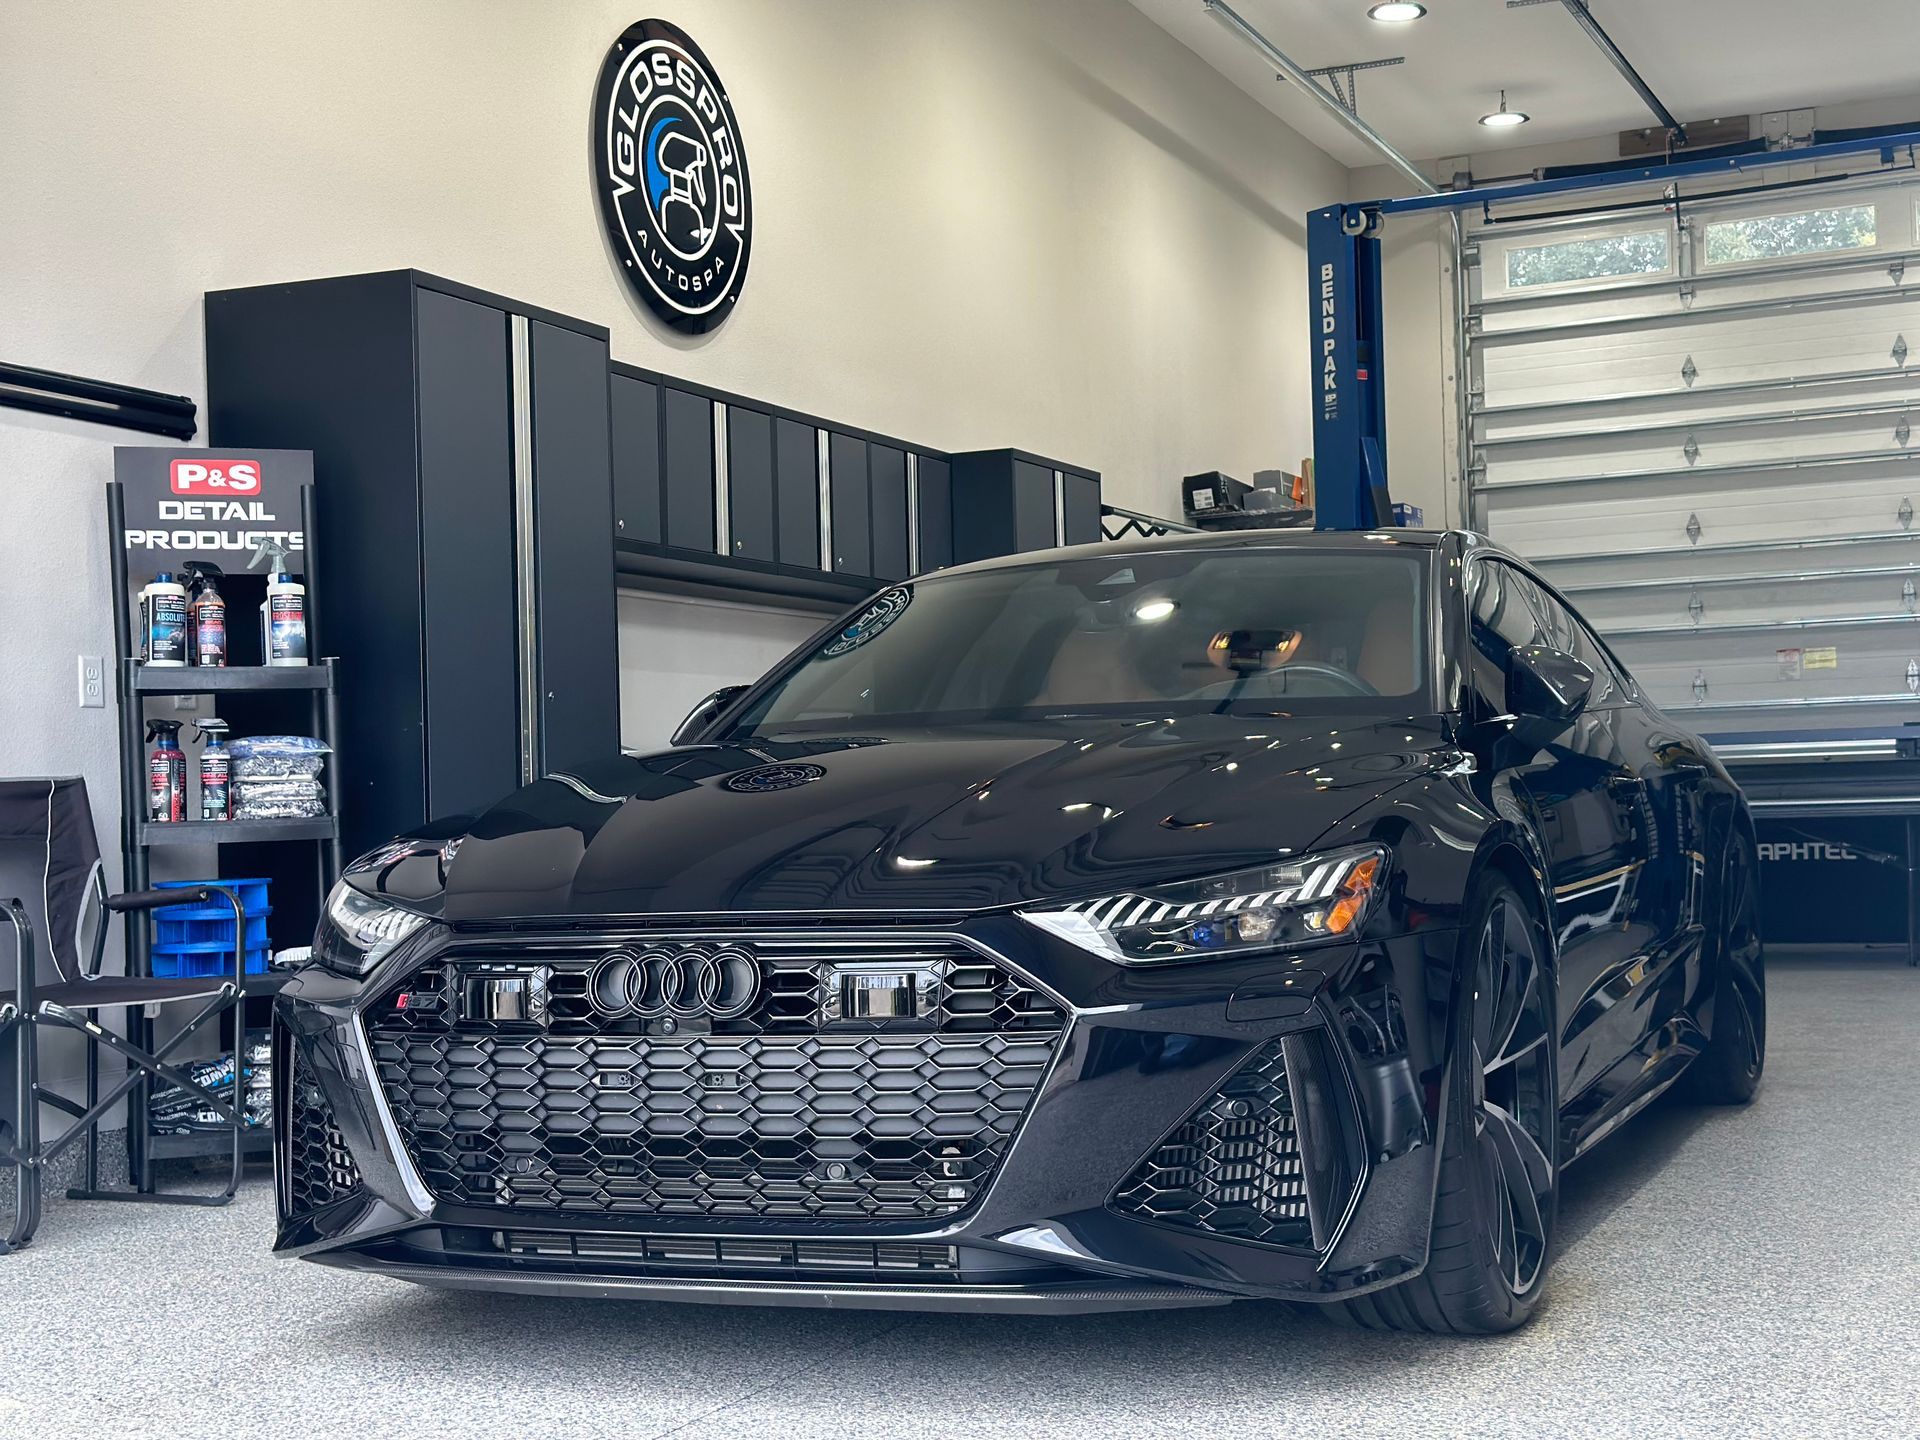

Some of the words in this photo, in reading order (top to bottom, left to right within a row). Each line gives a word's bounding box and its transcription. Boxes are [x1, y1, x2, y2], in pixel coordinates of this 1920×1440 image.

[617, 53, 738, 217] GLOSSPRO
[637, 229, 725, 292] AUTOSPA
[1321, 263, 1335, 334] BEND
[1323, 338, 1337, 391] PAK
[177, 464, 257, 490] P&S
[158, 500, 276, 521] DETAIL
[125, 530, 304, 550] PRODUCTS
